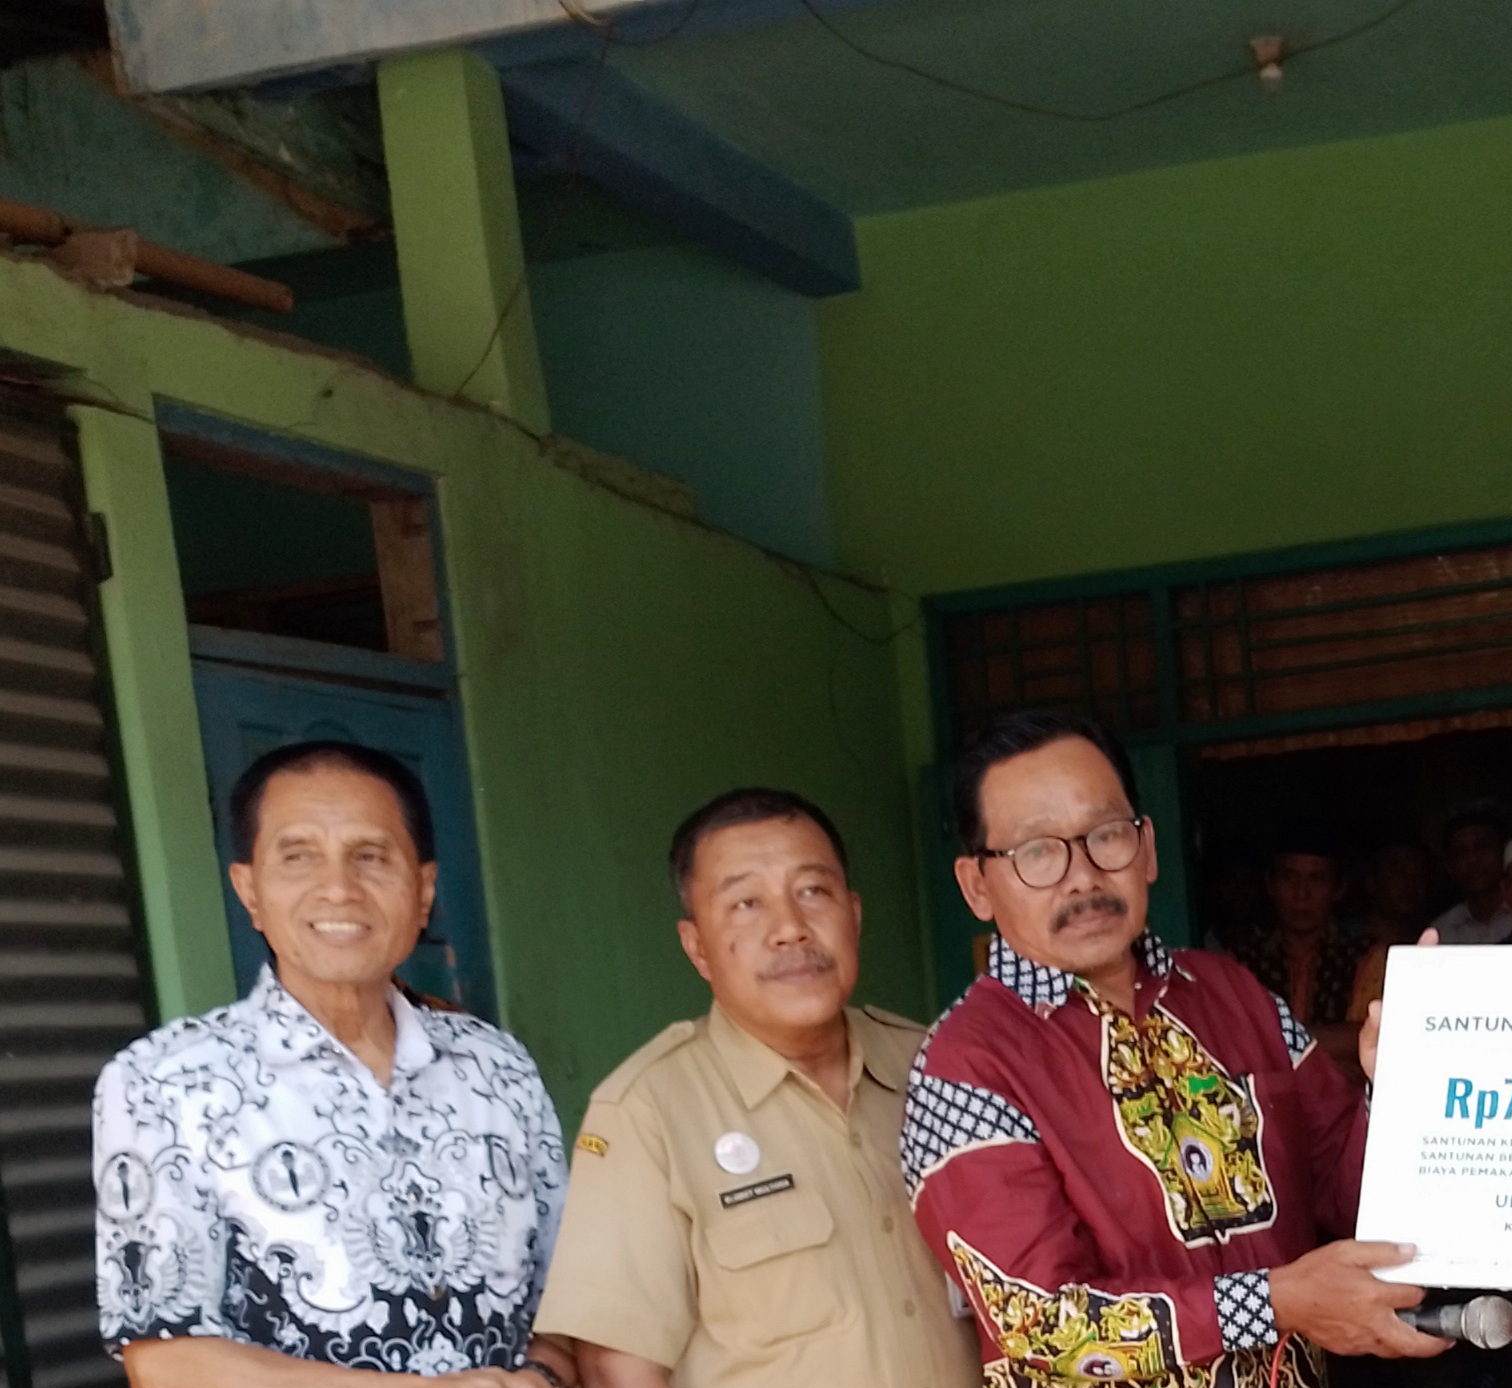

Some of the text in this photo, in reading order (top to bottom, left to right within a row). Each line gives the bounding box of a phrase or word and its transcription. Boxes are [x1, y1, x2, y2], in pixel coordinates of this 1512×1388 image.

[1422, 1136, 1496, 1147] SANTUNAN
[1420, 1151, 1495, 1162] SANTUNAN
[1418, 1166, 1457, 1176] BIAYA
